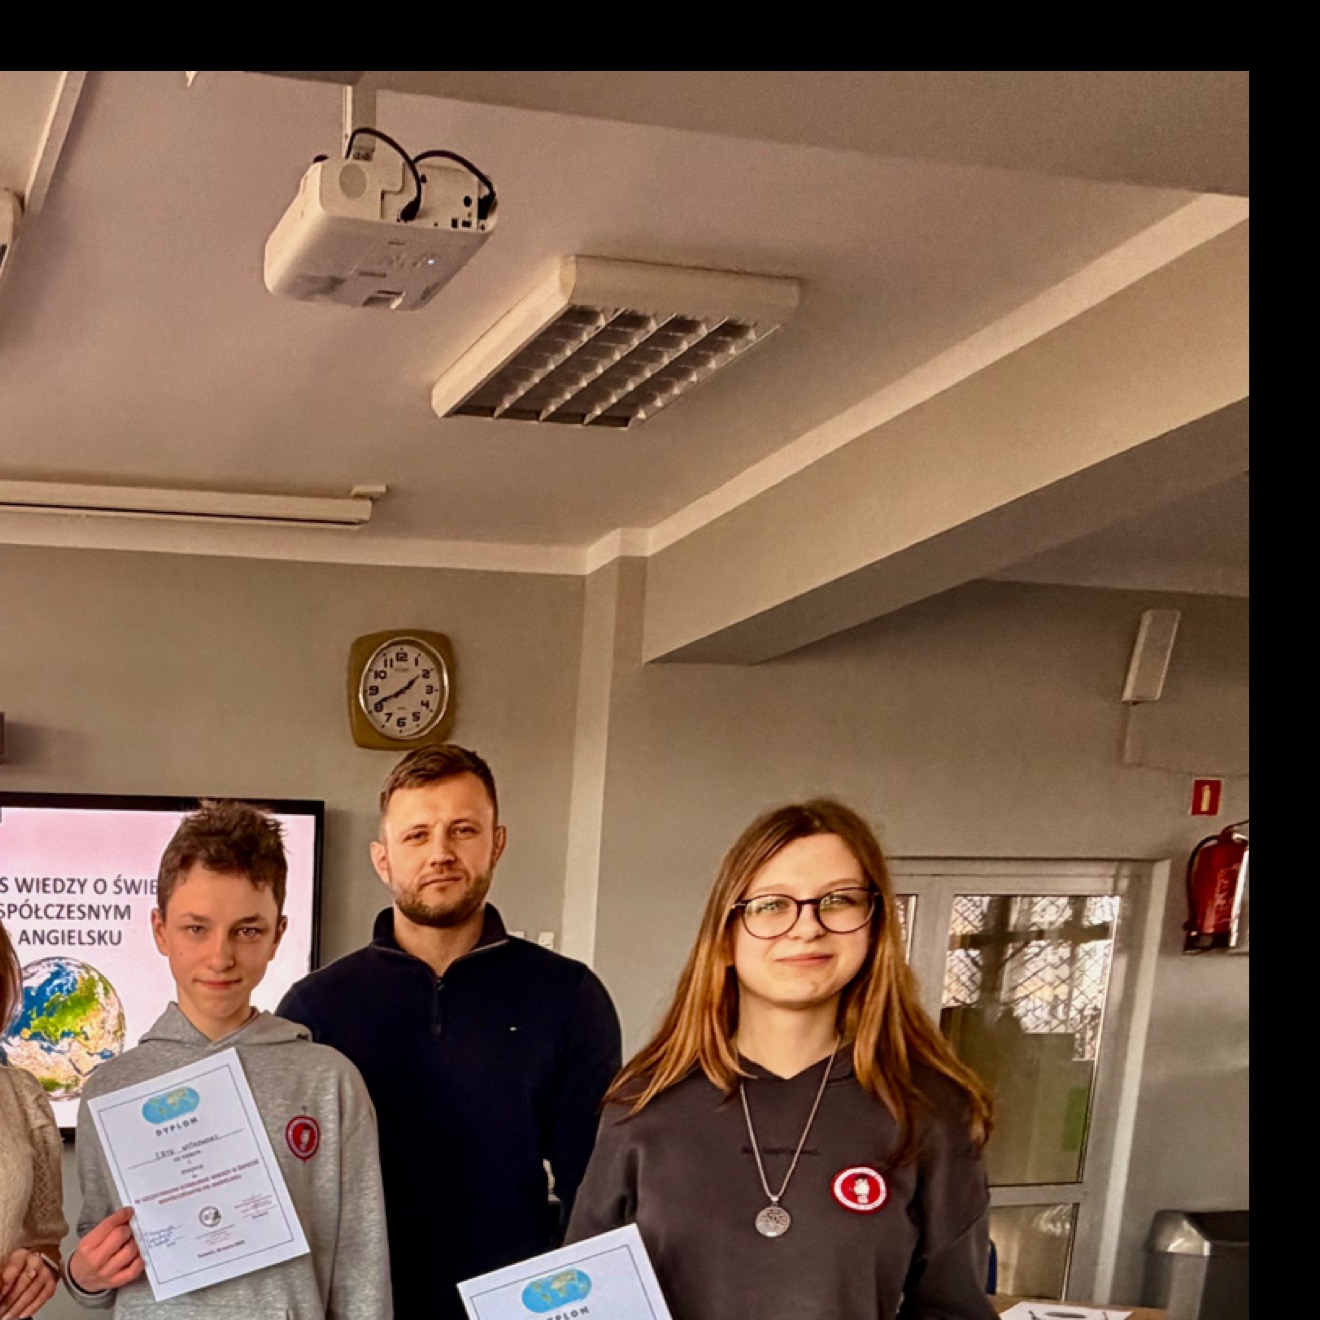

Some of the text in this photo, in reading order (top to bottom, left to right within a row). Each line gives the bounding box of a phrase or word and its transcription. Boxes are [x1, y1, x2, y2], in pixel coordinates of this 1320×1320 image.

[395, 652, 409, 662] 12
[373, 670, 388, 680] 10
[422, 669, 431, 680] 2
[368, 685, 380, 696] 9
[425, 685, 434, 695] 3
[420, 700, 430, 709] 4
[384, 712, 393, 723] 7
[396, 717, 407, 728] 6
[14, 877, 88, 895] WIEDZY
[92, 877, 108, 895] O
[112, 874, 159, 896] ŚWIE
[17, 928, 123, 947] ANGIELSKU
[155, 1116, 198, 1137] DYPLOM
